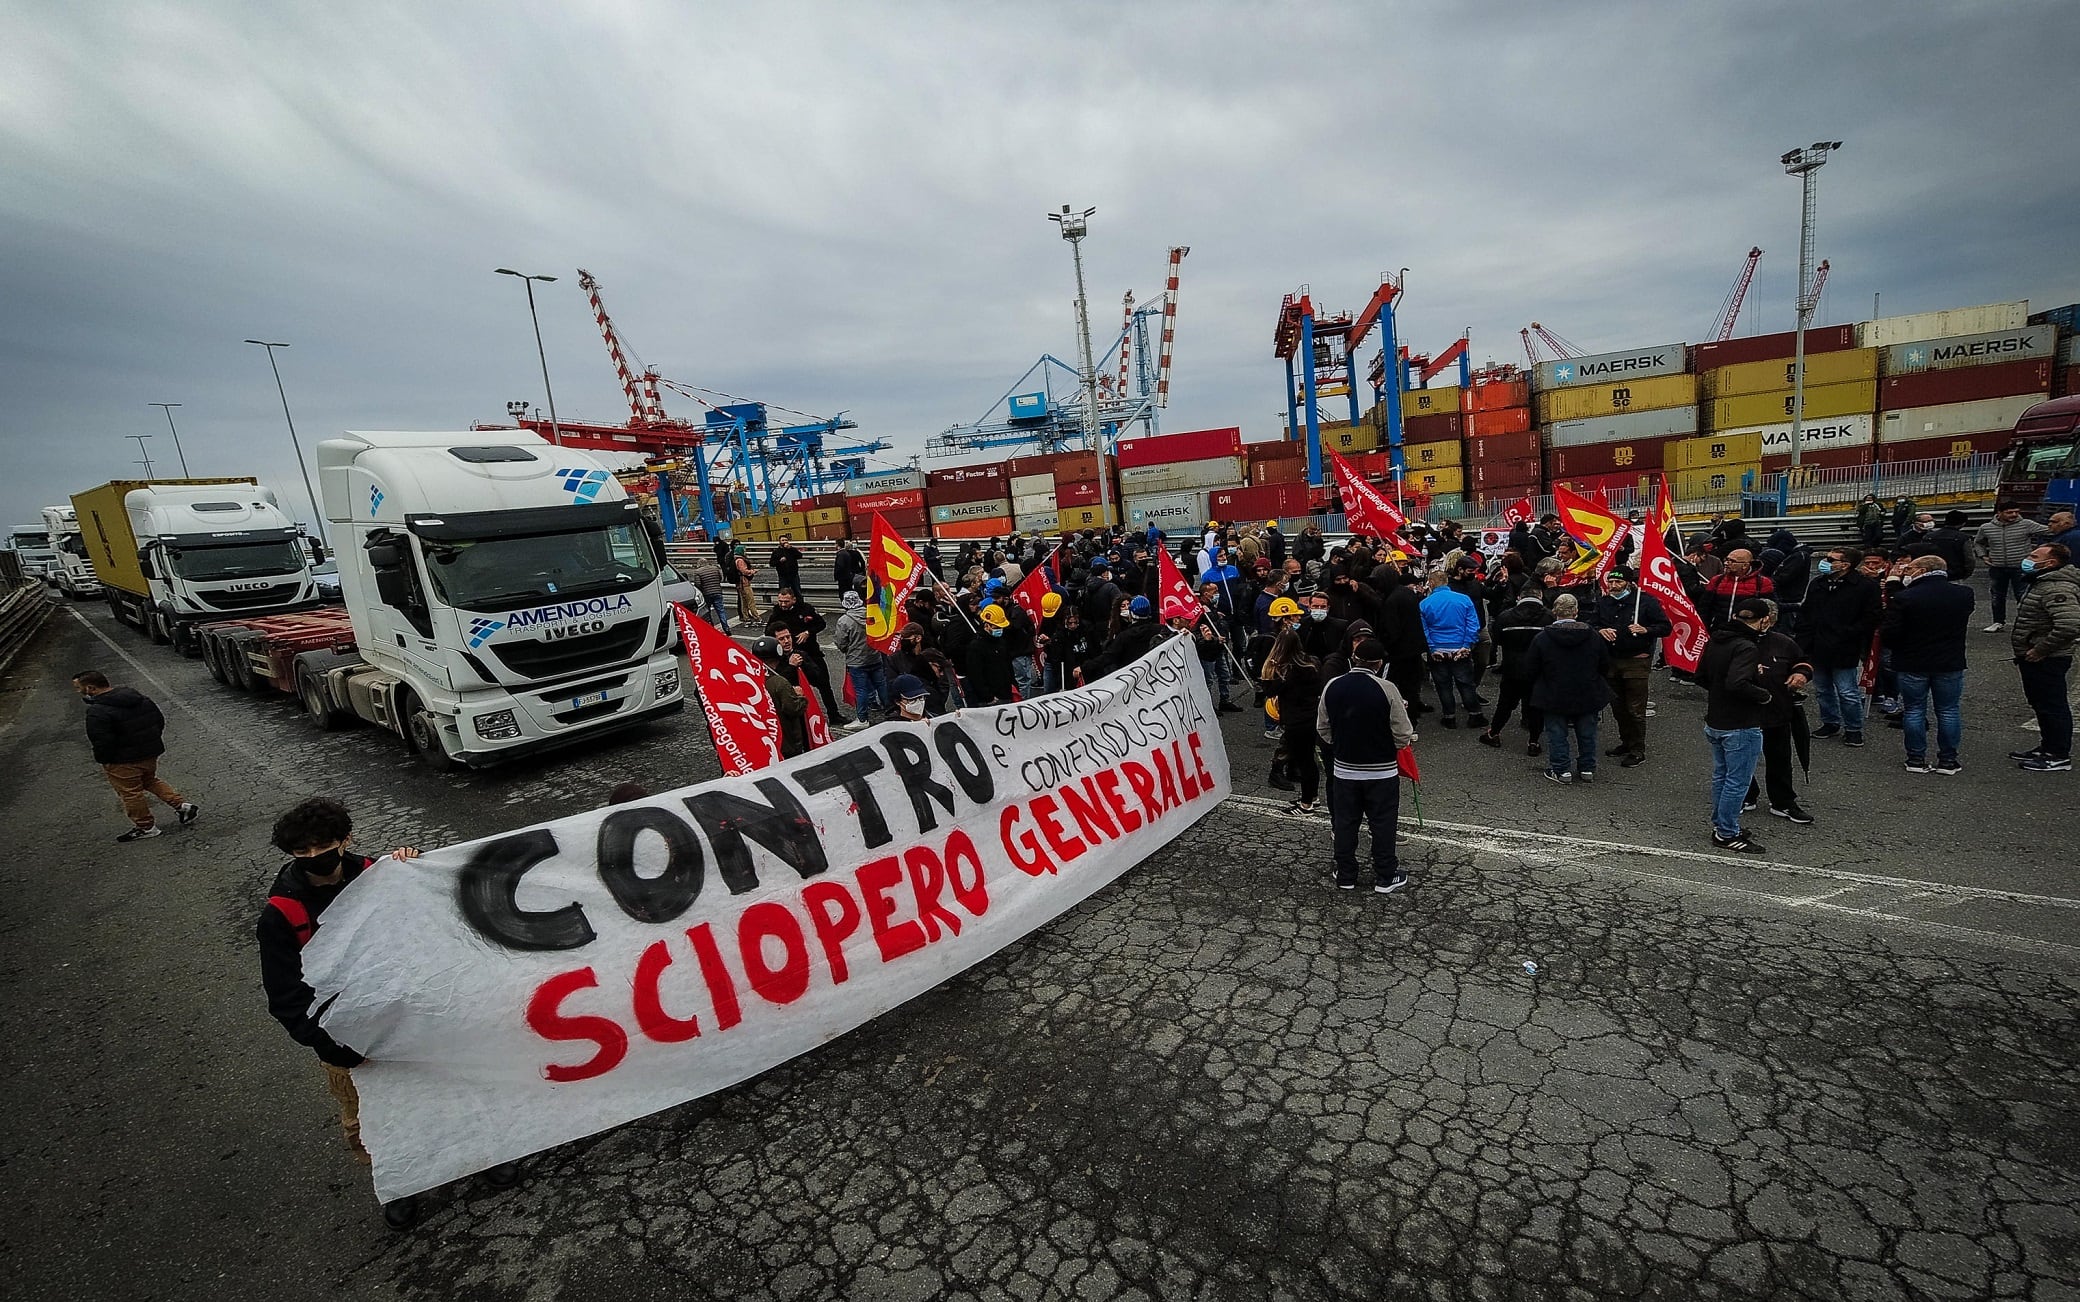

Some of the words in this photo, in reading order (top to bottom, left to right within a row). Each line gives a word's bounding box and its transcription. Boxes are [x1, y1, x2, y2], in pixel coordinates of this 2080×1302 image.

[1933, 336, 2034, 361] MAERSK
[1579, 354, 1665, 377] MAERSK
[865, 477, 911, 490] MAERSK
[942, 473, 954, 481] The
[966, 470, 985, 478] Factor
[951, 504, 999, 517] MAERSK
[1144, 507, 1190, 519] MAERSK
[229, 581, 269, 591] IVECO
[506, 594, 632, 629] AMENDOLA
[509, 619, 568, 636] TRASPORTI
[583, 607, 633, 622] LOGISTICA
[300, 636, 336, 645] AMENDOL
[545, 620, 605, 641] IVECO
[1118, 639, 1194, 705] DRAGHI
[1020, 687, 1207, 792] CONFINDUSTRIA
[991, 743, 1010, 769] e
[454, 721, 996, 951] CONTRO
[525, 828, 990, 1082] SCIOPERO
[1000, 731, 1215, 877] GENERALE
